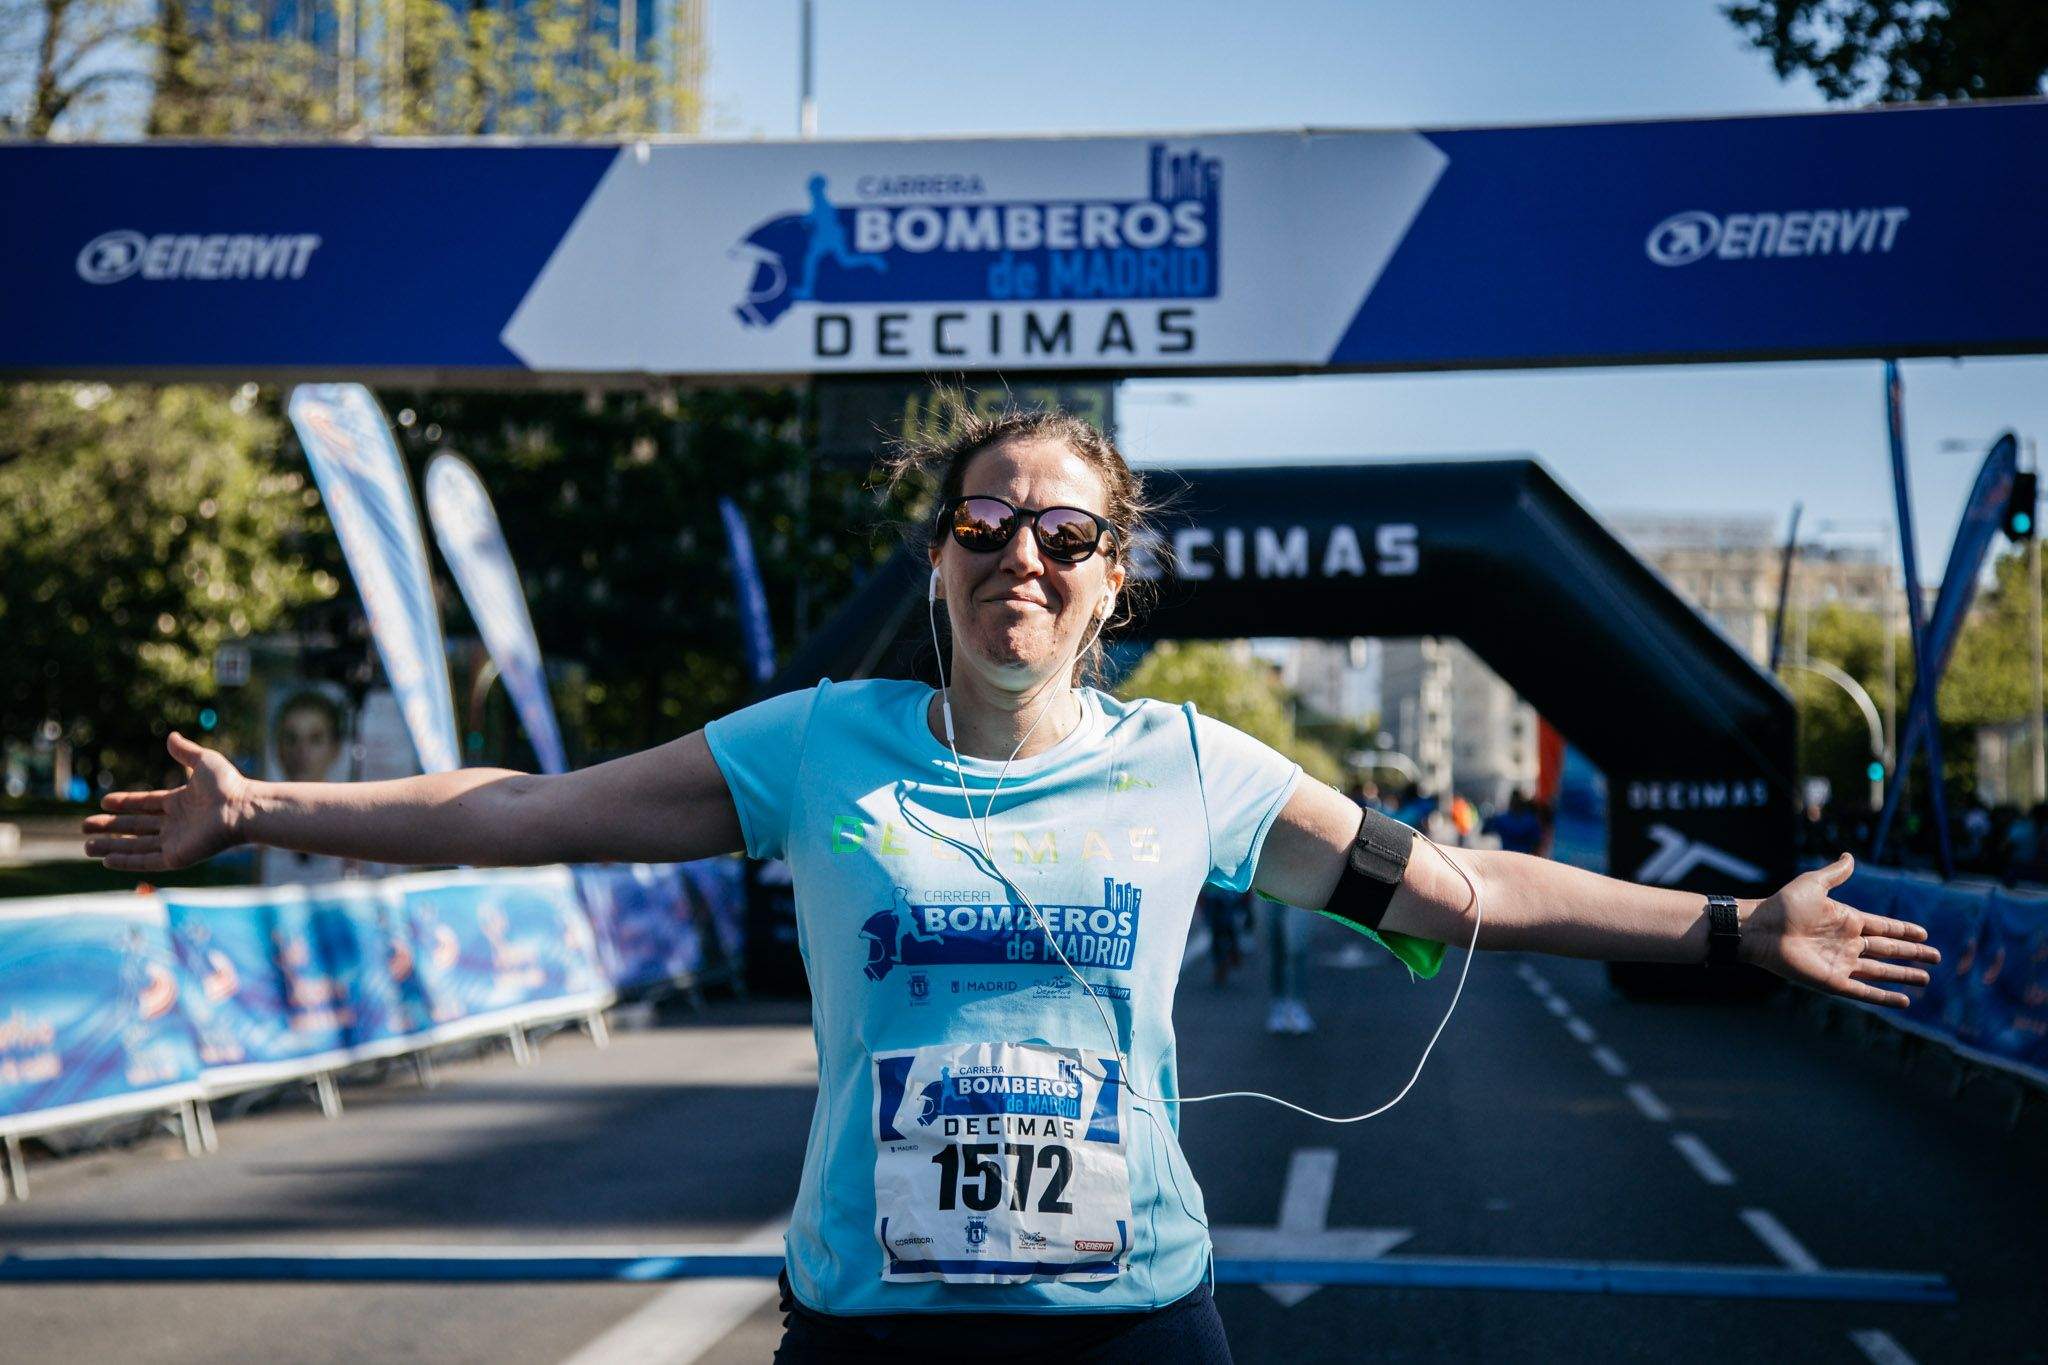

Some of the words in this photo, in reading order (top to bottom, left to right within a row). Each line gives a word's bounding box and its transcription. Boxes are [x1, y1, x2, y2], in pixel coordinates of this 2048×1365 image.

[857, 175, 985, 197] CARRERA
[855, 202, 1206, 252] BOMBEROS
[1718, 206, 1909, 259] ENERVIT
[141, 233, 321, 280] ENERVIT
[988, 252, 1037, 298] de
[1050, 250, 1210, 297] MADRID
[814, 308, 1196, 357] DECIMAS
[1130, 524, 1419, 580] ECIMAS
[1627, 780, 1768, 810] DECIMAS
[924, 890, 991, 902] CARRERA
[924, 906, 1132, 937] BOMBEROS
[1006, 933, 1034, 961] de
[1043, 933, 1131, 967] MADRID
[967, 980, 1018, 992] MADRID
[959, 1066, 1004, 1075] CARRERA
[959, 1077, 1079, 1099] BOMBEROS
[1006, 1095, 1024, 1113] de
[1028, 1096, 1077, 1117] MADRID
[944, 1117, 1074, 1139] DECIMAS
[932, 1142, 1074, 1215] 1572
